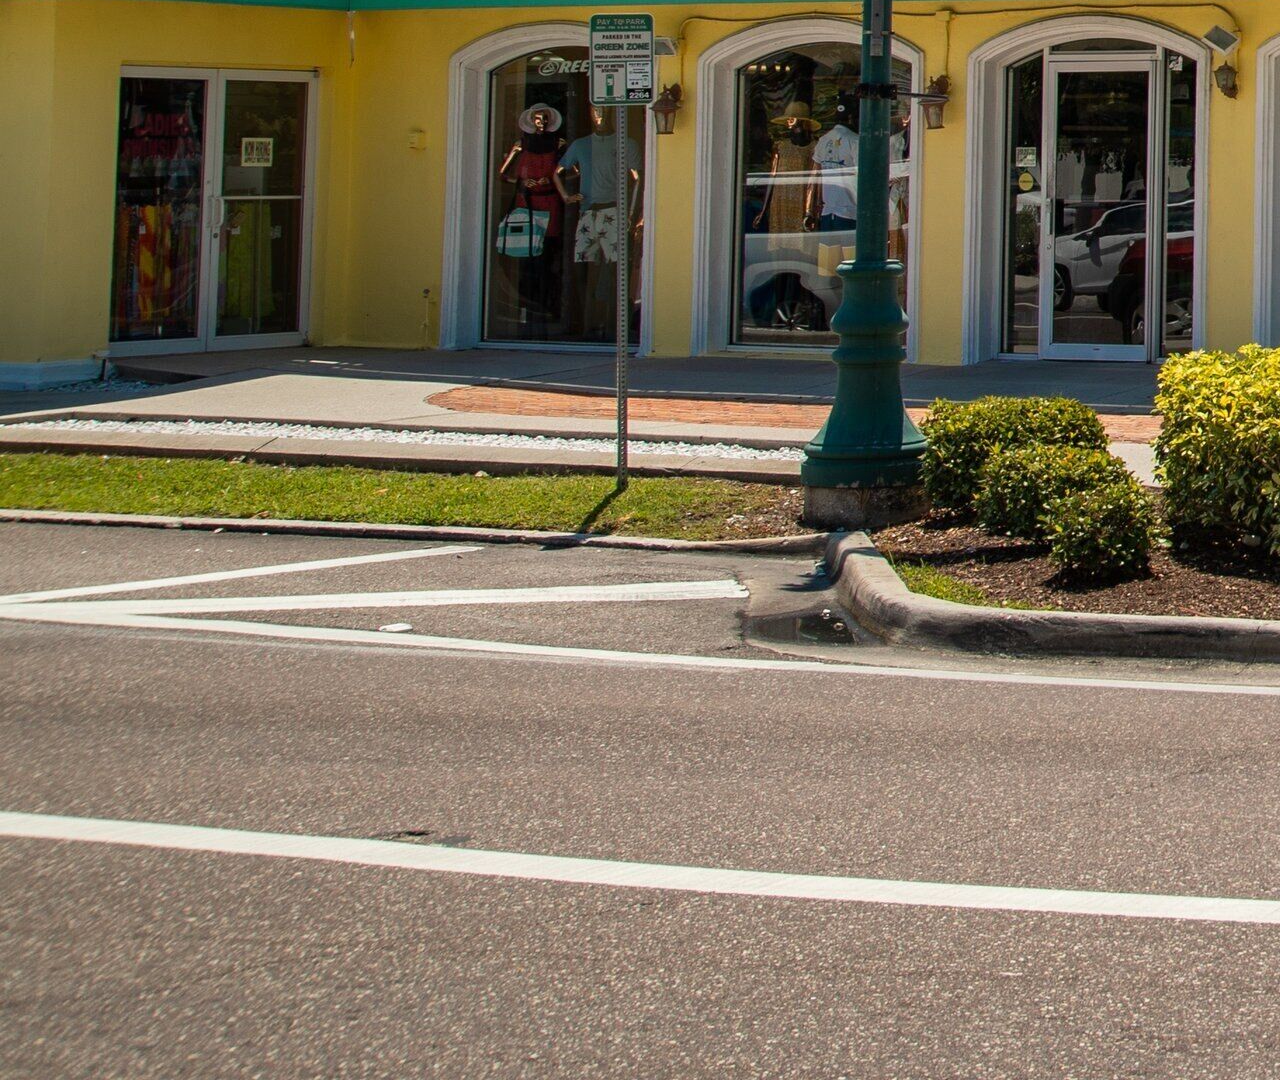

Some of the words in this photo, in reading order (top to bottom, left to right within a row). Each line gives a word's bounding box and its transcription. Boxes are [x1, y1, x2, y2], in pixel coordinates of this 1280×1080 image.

[594, 43, 624, 51] GREEN
[626, 42, 650, 51] ZONE
[558, 59, 589, 76] REE
[244, 140, 254, 157] NOW
[255, 140, 271, 157] HIRING
